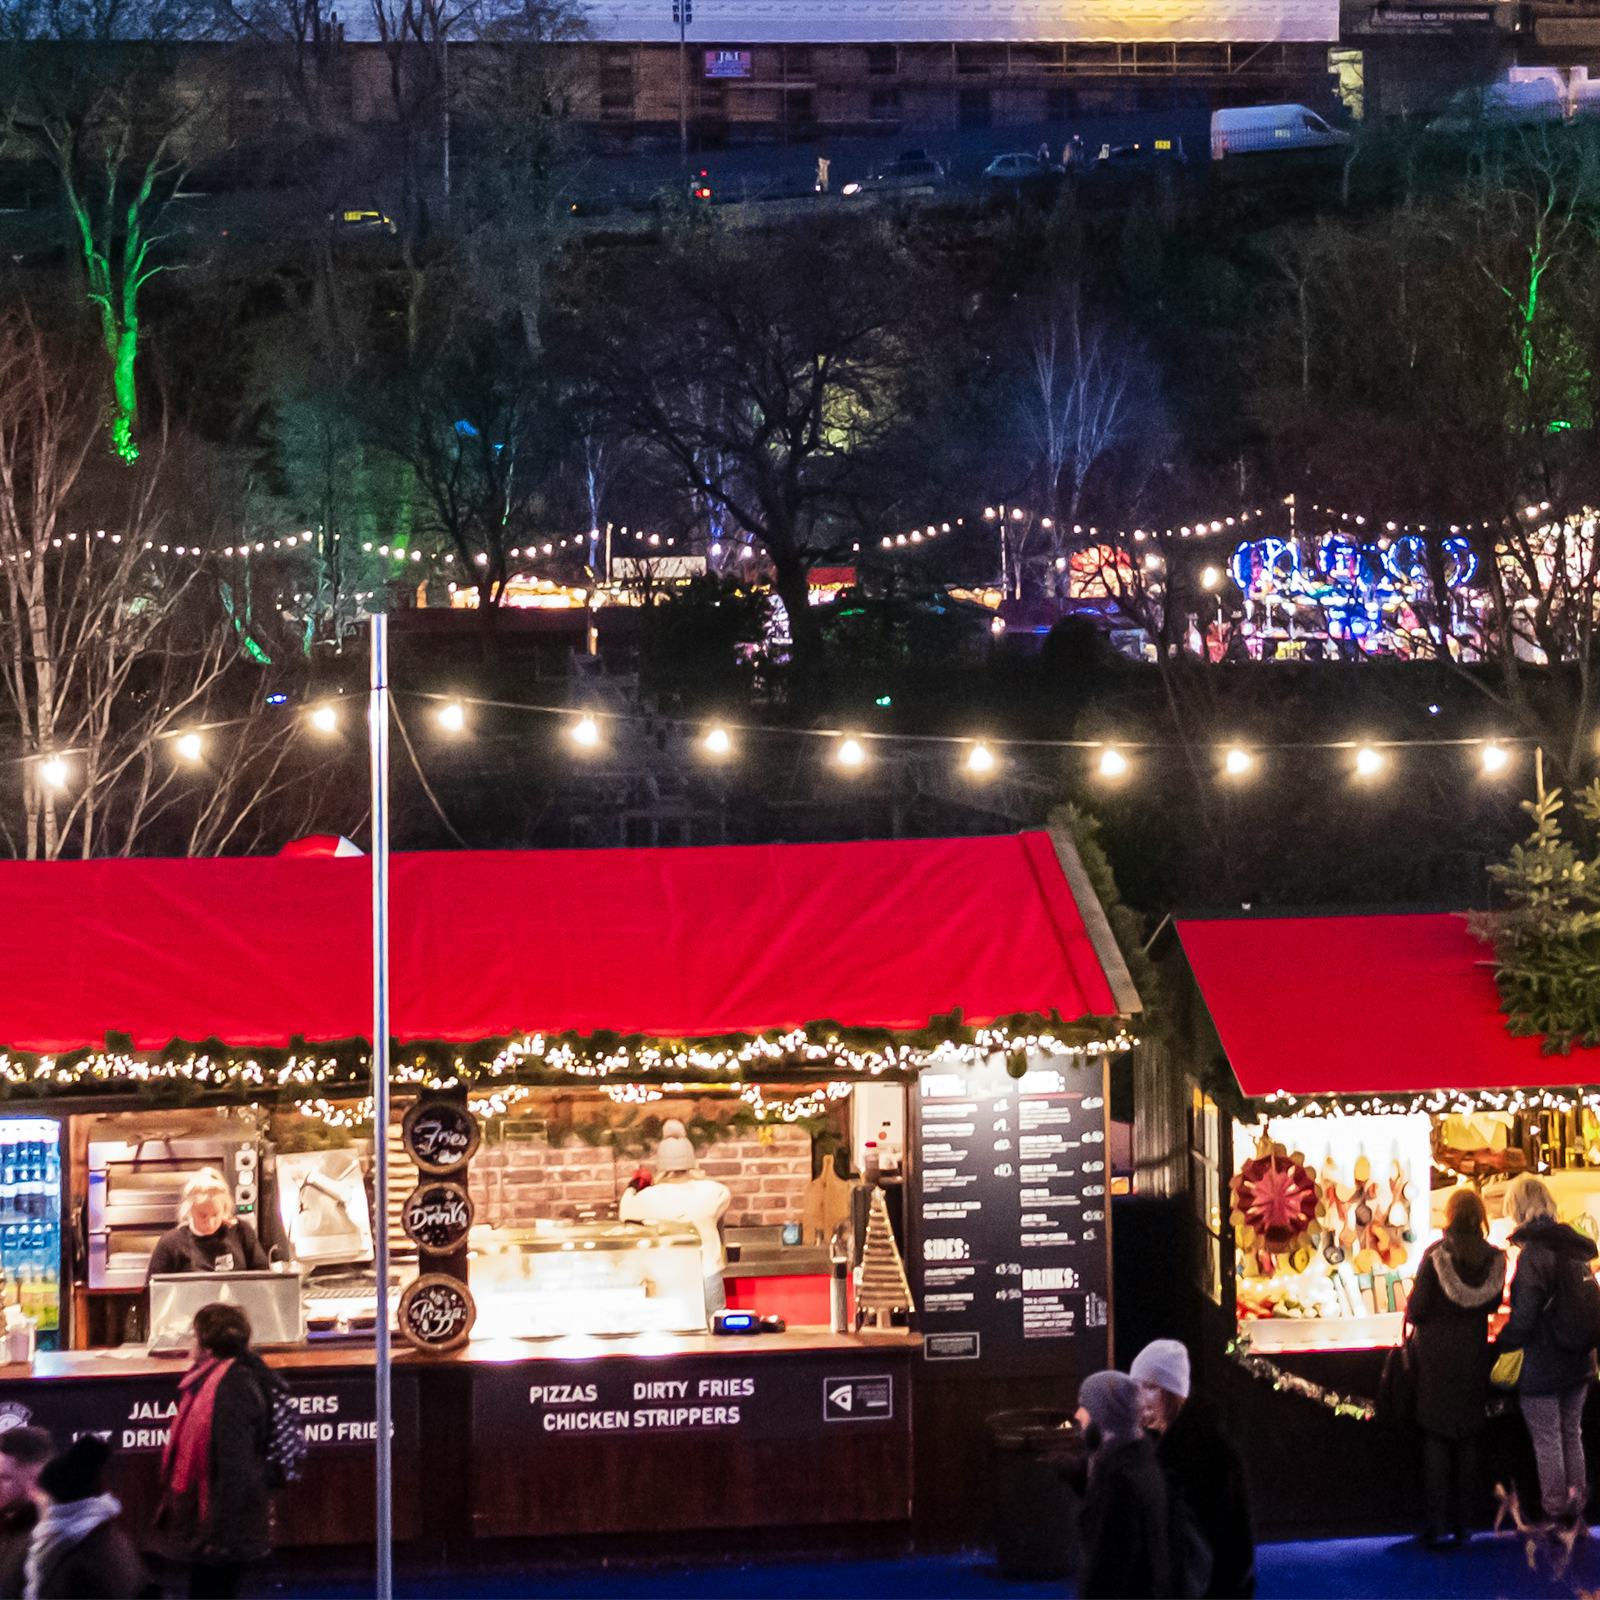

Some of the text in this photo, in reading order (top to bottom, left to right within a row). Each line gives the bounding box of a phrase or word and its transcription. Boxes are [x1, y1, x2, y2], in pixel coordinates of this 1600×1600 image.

[529, 1378, 756, 1404] PIZZAS DIRTY FRIES
[127, 1396, 339, 1420] JALA PERS
[543, 1406, 741, 1432] CHICKEN STRIPPERS
[122, 1429, 172, 1448] DRIN
[303, 1423, 334, 1442] ND
